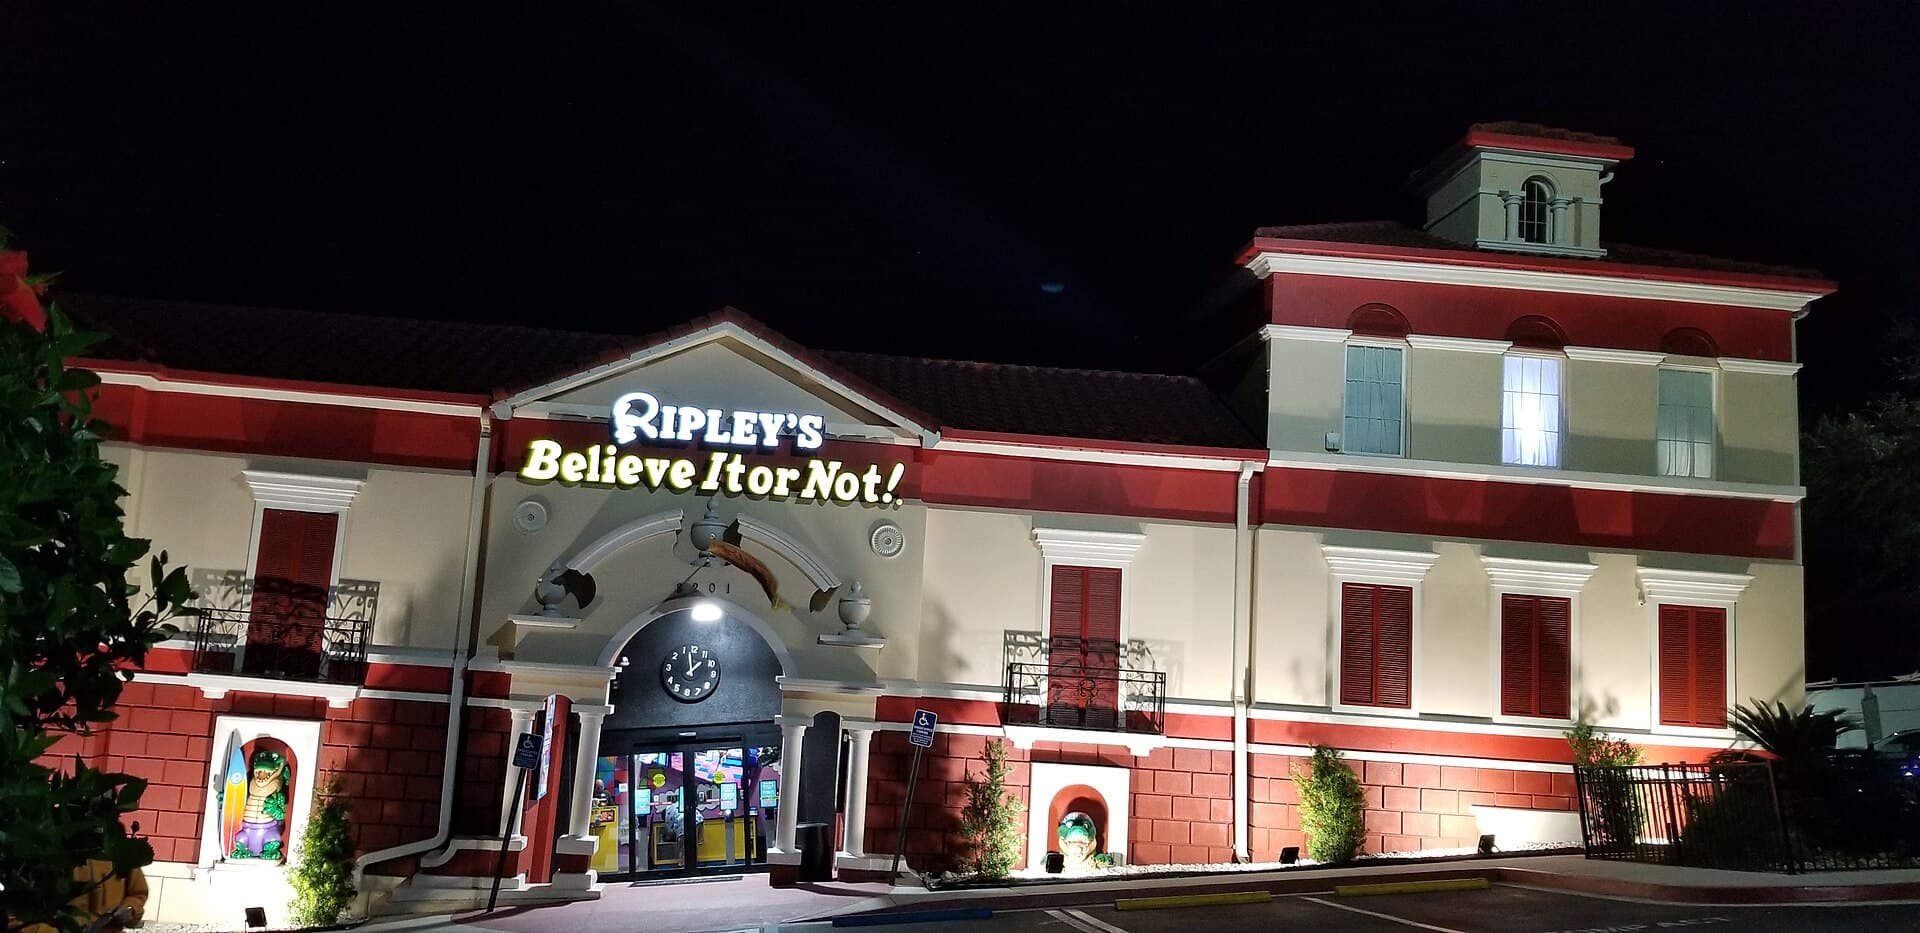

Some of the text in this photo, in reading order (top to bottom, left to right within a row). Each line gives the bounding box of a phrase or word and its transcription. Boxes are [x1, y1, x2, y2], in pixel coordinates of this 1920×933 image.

[521, 438, 905, 504] Believe It or Not!
[676, 582, 731, 595] 8201
